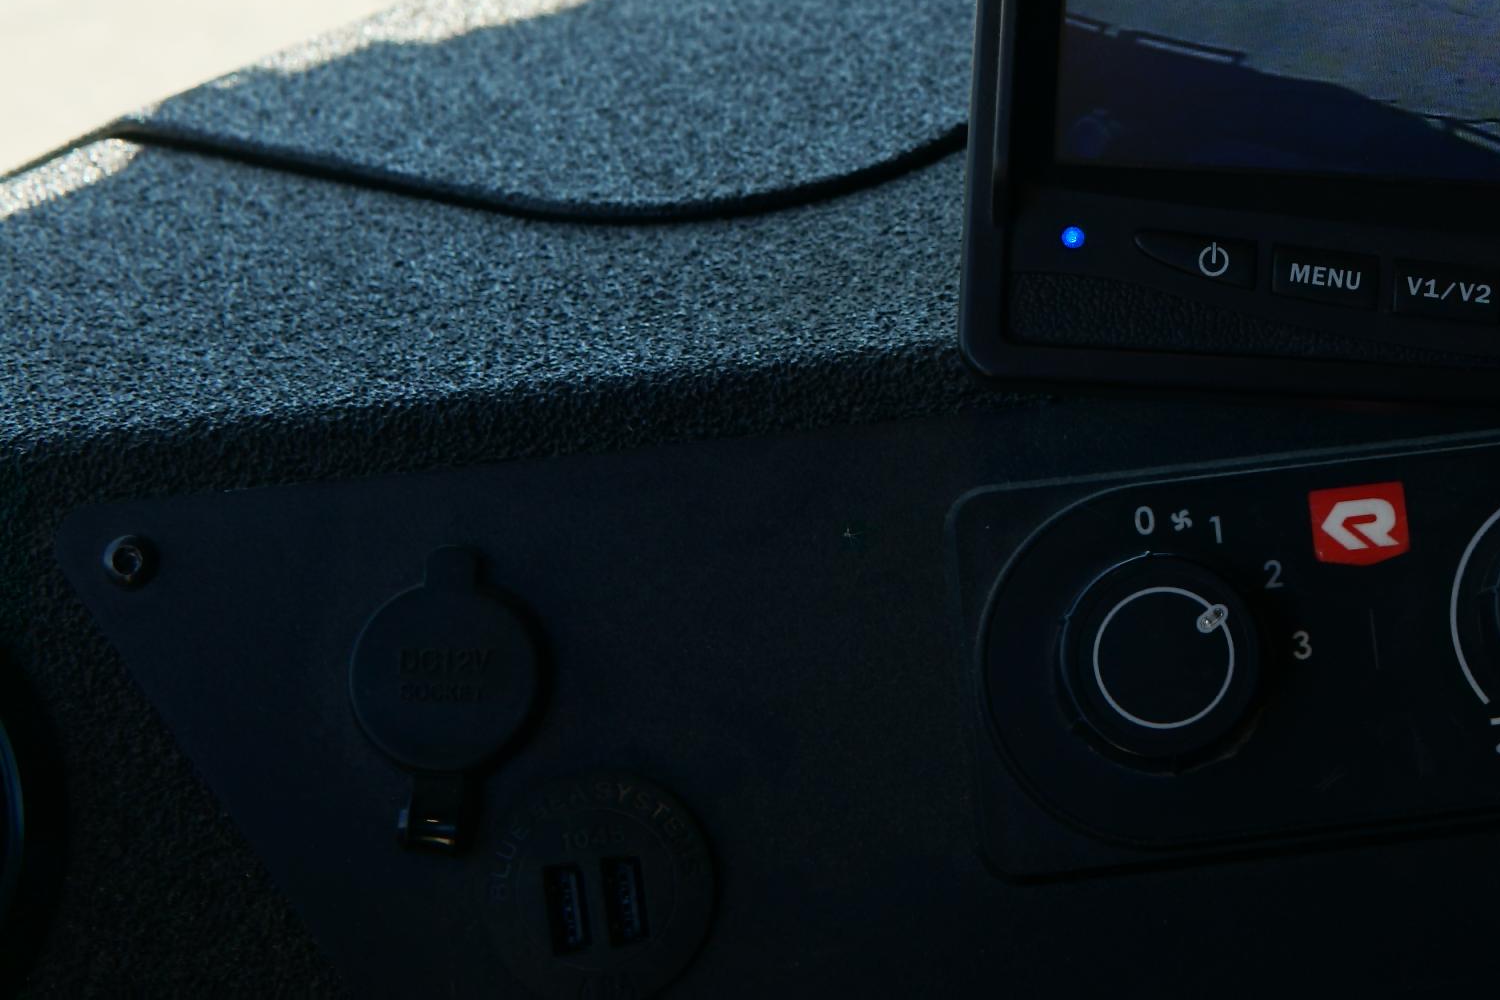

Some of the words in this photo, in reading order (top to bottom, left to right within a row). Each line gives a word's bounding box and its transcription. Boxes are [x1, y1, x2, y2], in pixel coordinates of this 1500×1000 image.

[1289, 262, 1361, 290] MENU
[1407, 276, 1492, 304] V1/V2
[1133, 505, 1155, 536] 0
[1207, 515, 1223, 544] 1
[1262, 559, 1284, 589] 2
[1292, 630, 1313, 660] 3
